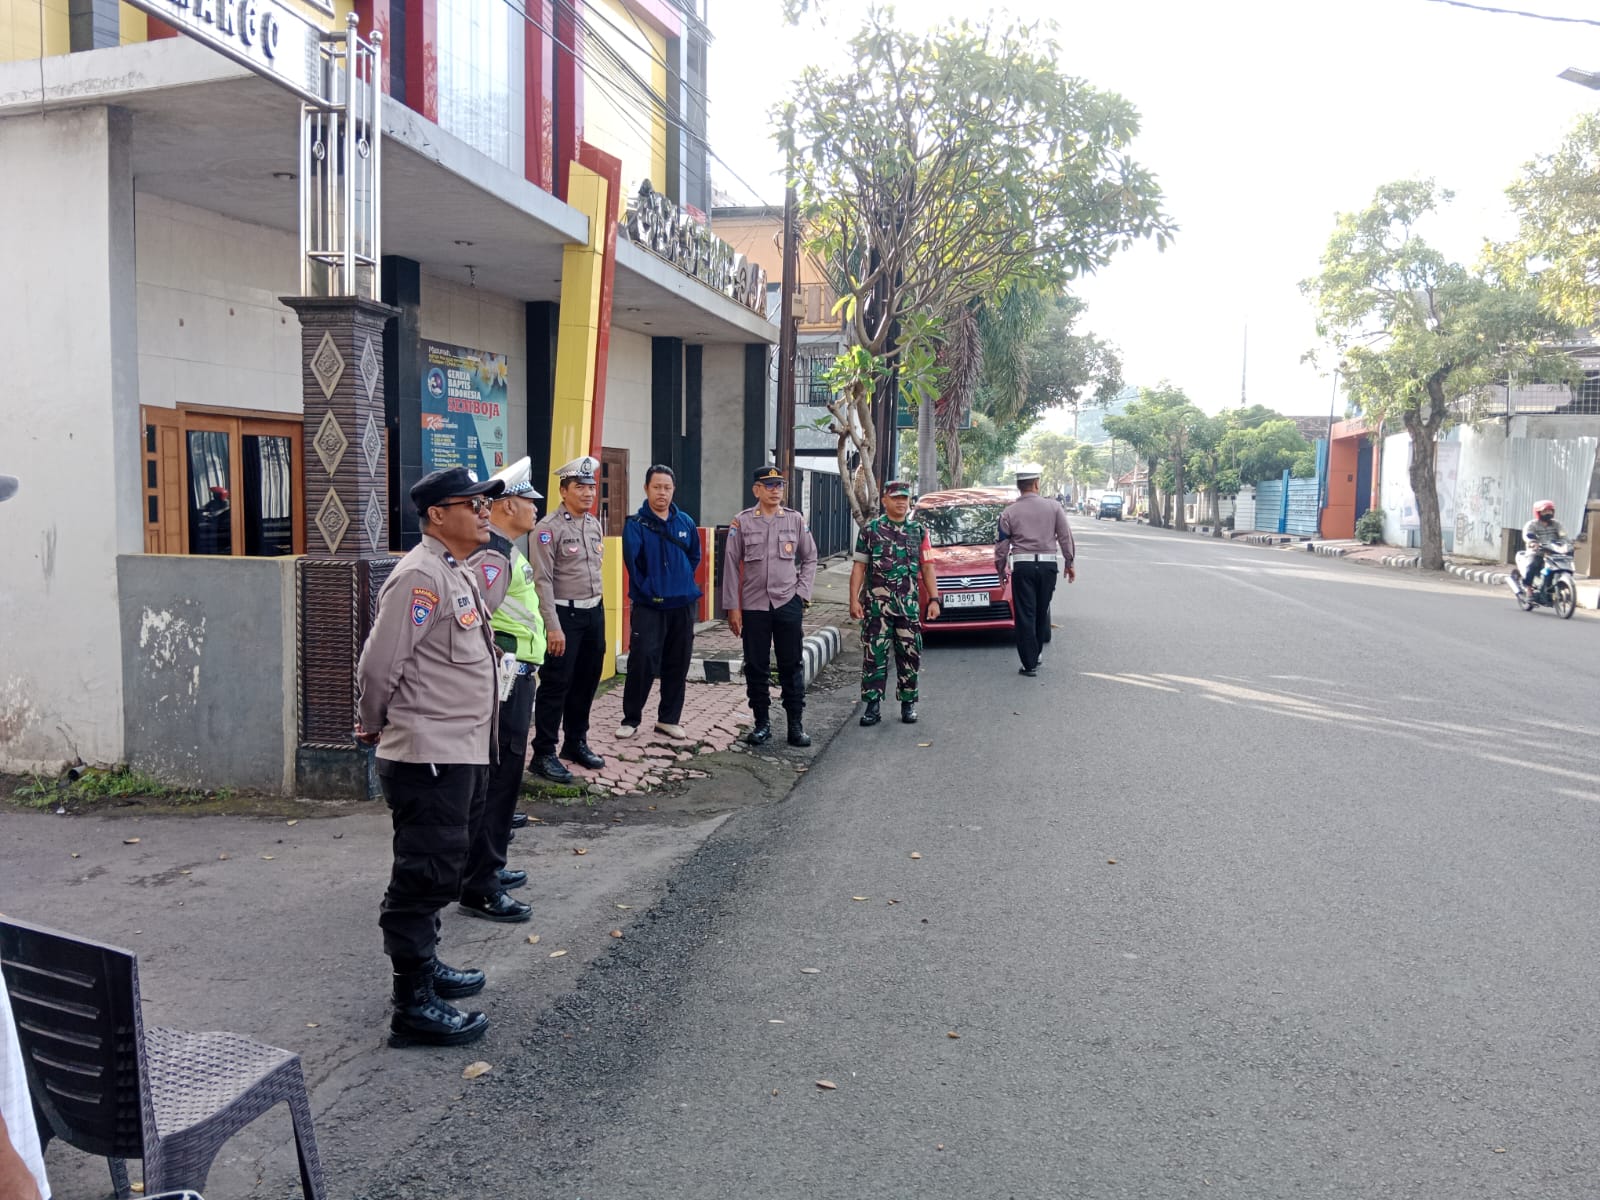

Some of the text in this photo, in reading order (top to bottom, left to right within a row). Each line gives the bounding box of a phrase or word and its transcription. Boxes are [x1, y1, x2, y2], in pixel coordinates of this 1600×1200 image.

[167, 0, 277, 59] ARGO
[447, 369, 470, 381] GEREJA
[447, 378, 471, 390] BAPTIS
[448, 387, 481, 401] INDONESIA
